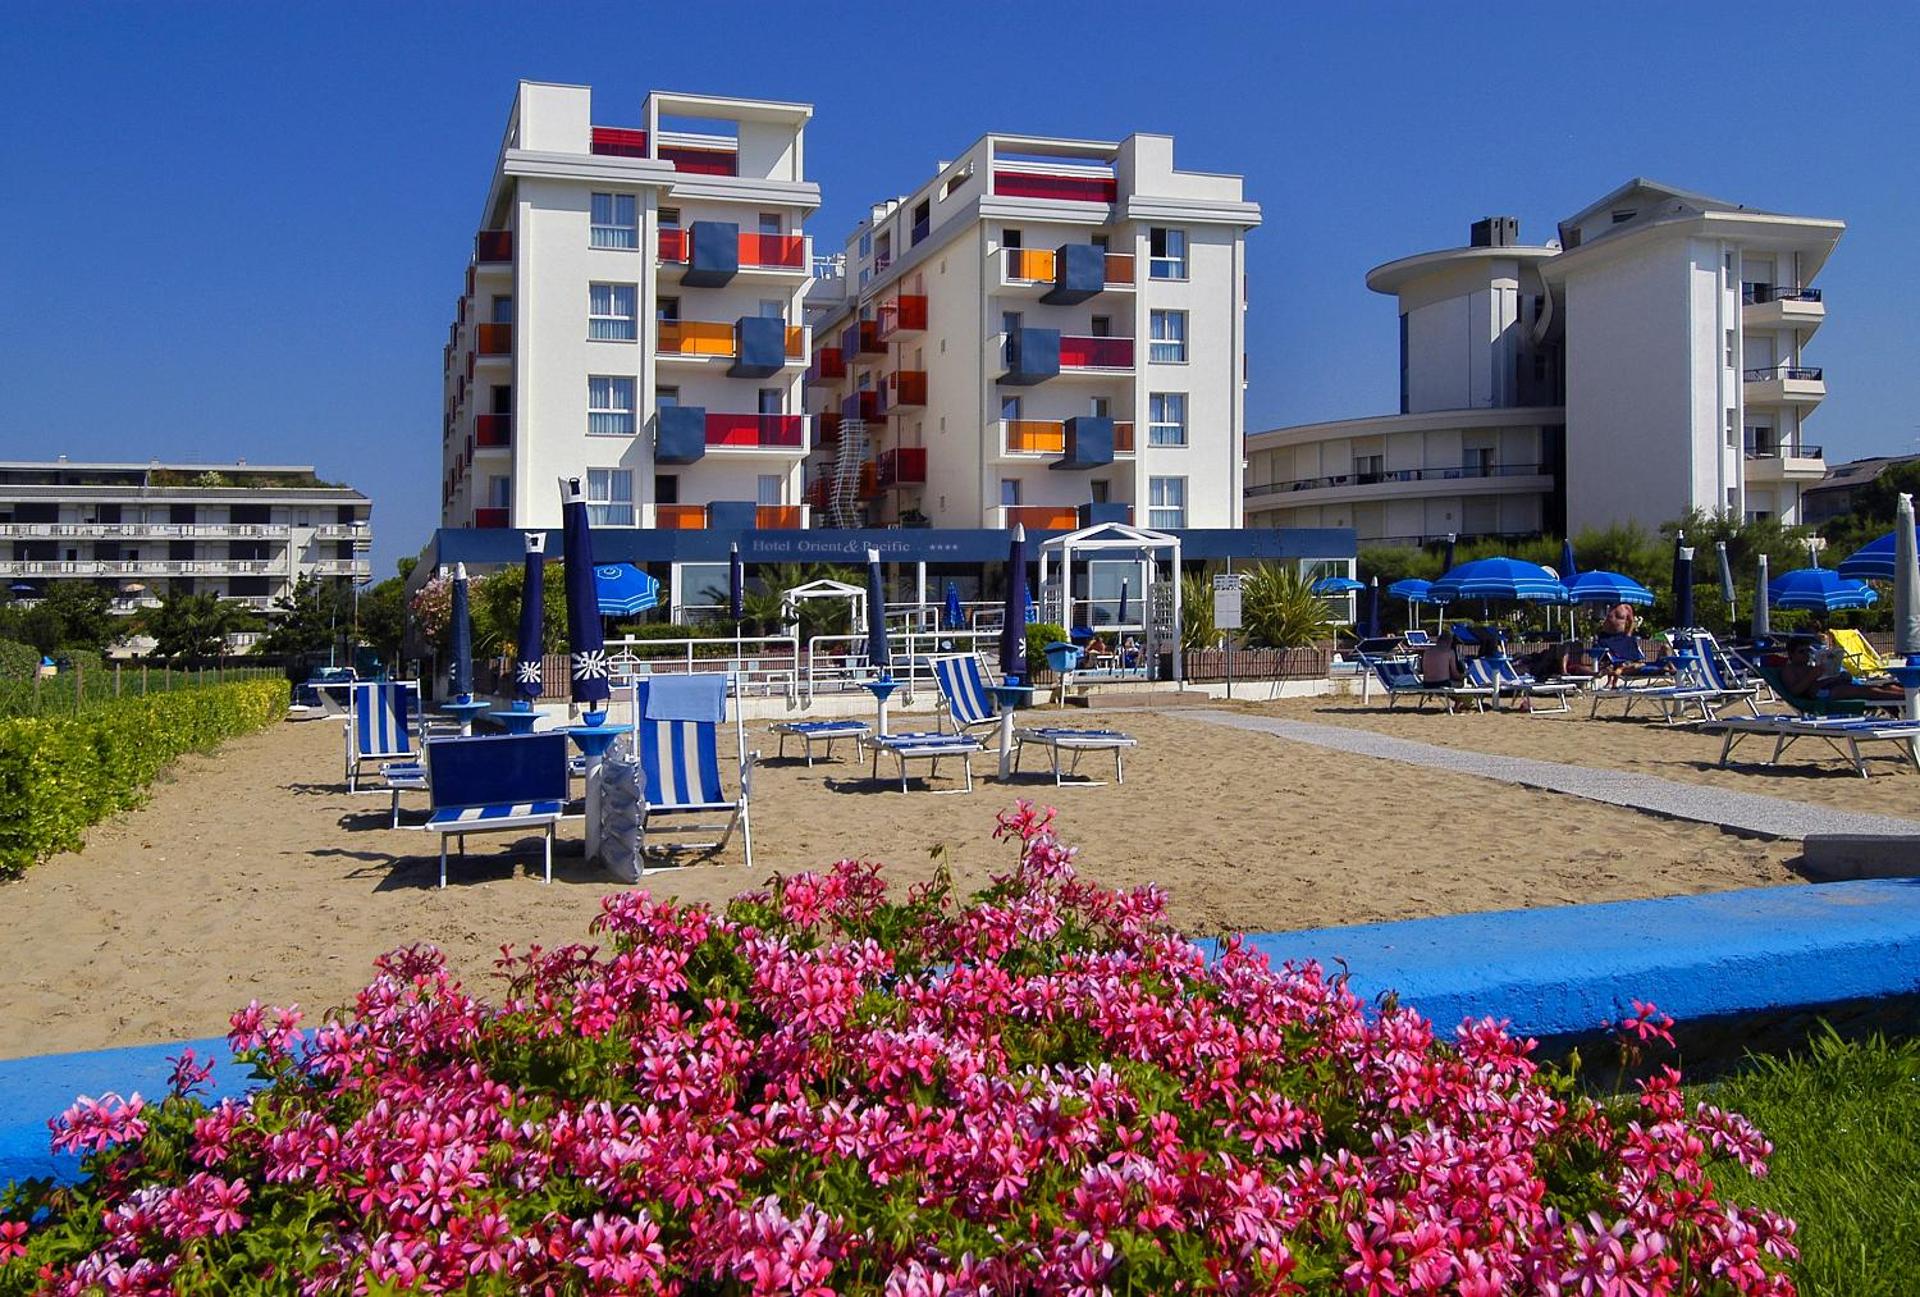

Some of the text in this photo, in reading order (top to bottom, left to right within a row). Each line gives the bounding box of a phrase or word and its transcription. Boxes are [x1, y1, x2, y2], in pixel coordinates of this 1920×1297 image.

[753, 540, 790, 552] Hotel
[798, 540, 841, 552] Orient
[843, 539, 858, 553] &
